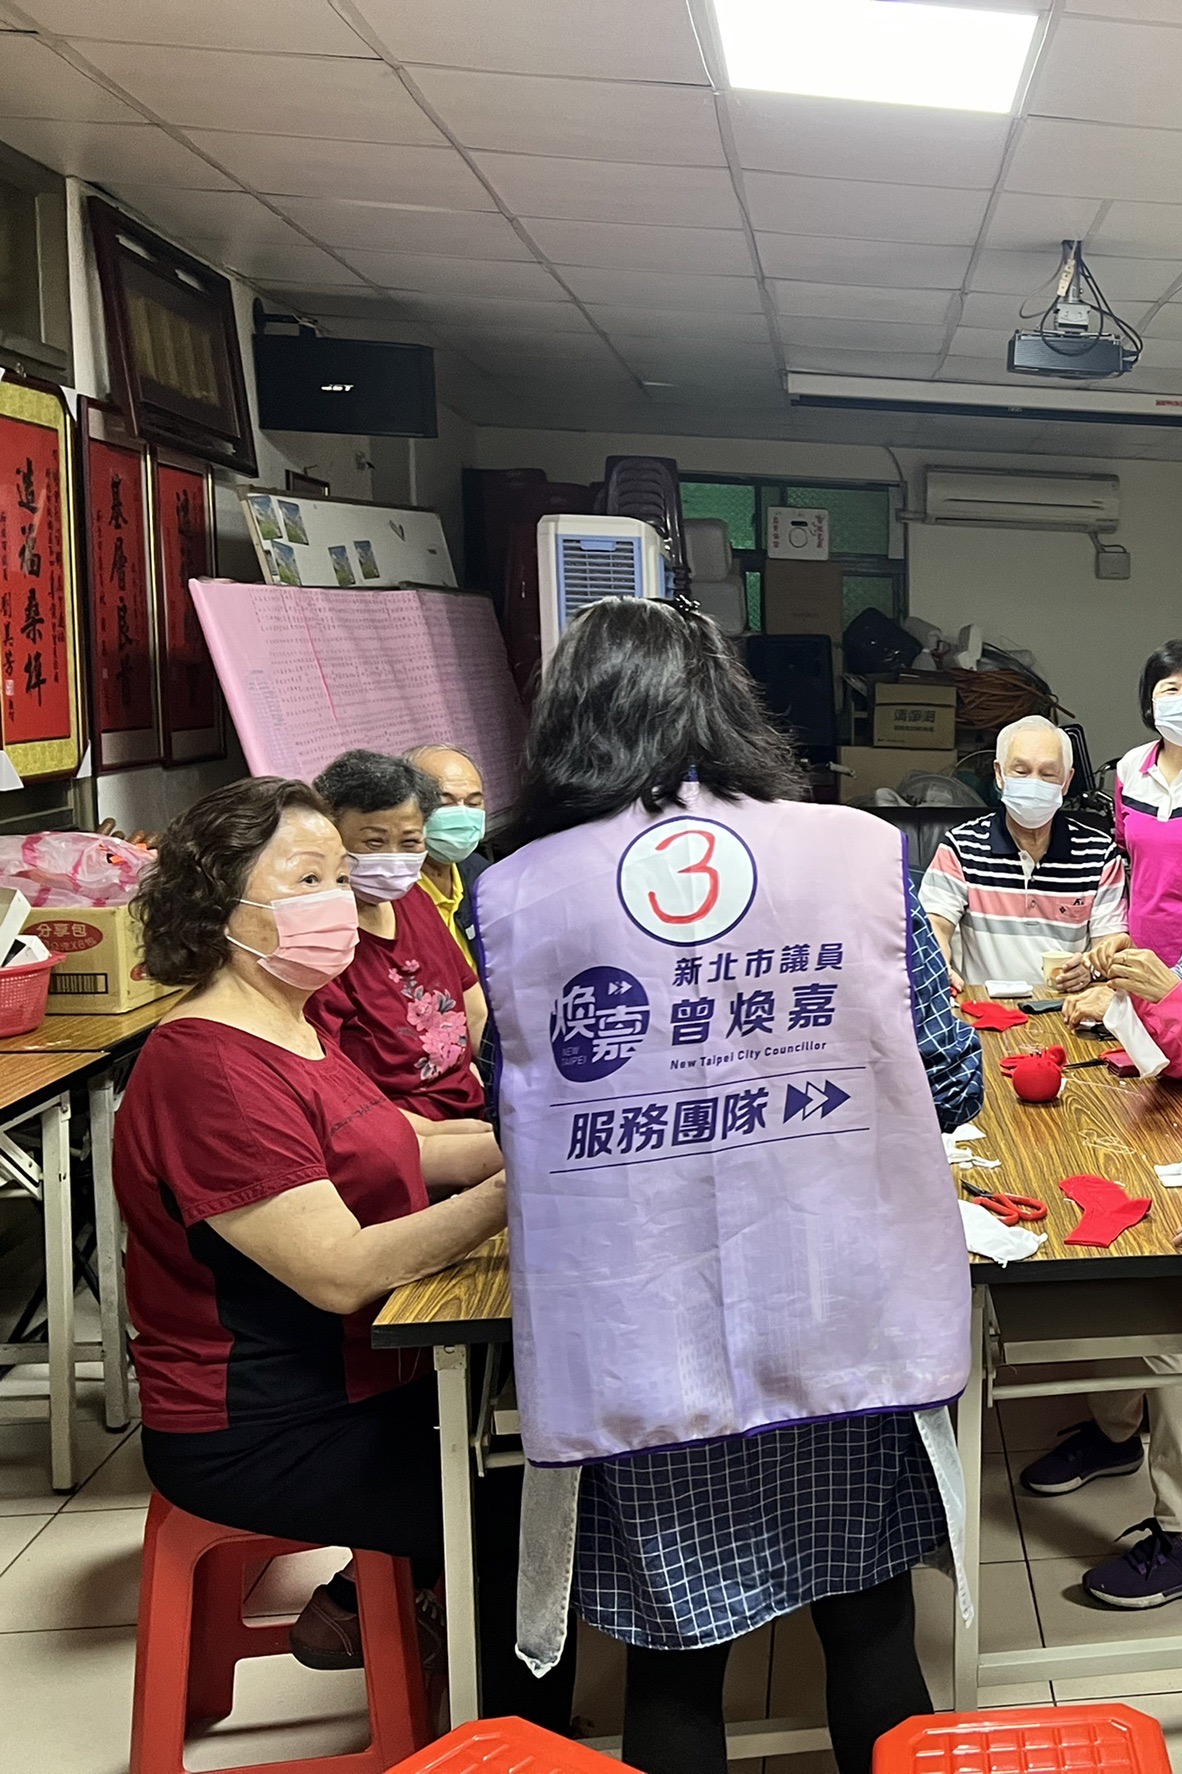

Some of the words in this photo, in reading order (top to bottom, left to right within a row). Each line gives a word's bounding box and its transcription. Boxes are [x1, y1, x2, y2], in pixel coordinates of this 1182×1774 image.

[648, 829, 721, 925] 3
[36, 923, 88, 938] 分享包
[672, 942, 844, 987] 新北市議員
[669, 982, 839, 1047] 曾煥嘉
[669, 1058, 697, 1070] New
[700, 1052, 734, 1068] Taipei
[737, 1047, 761, 1061] City
[764, 1040, 827, 1057] Councillor
[566, 1087, 769, 1161] 服務團隊
